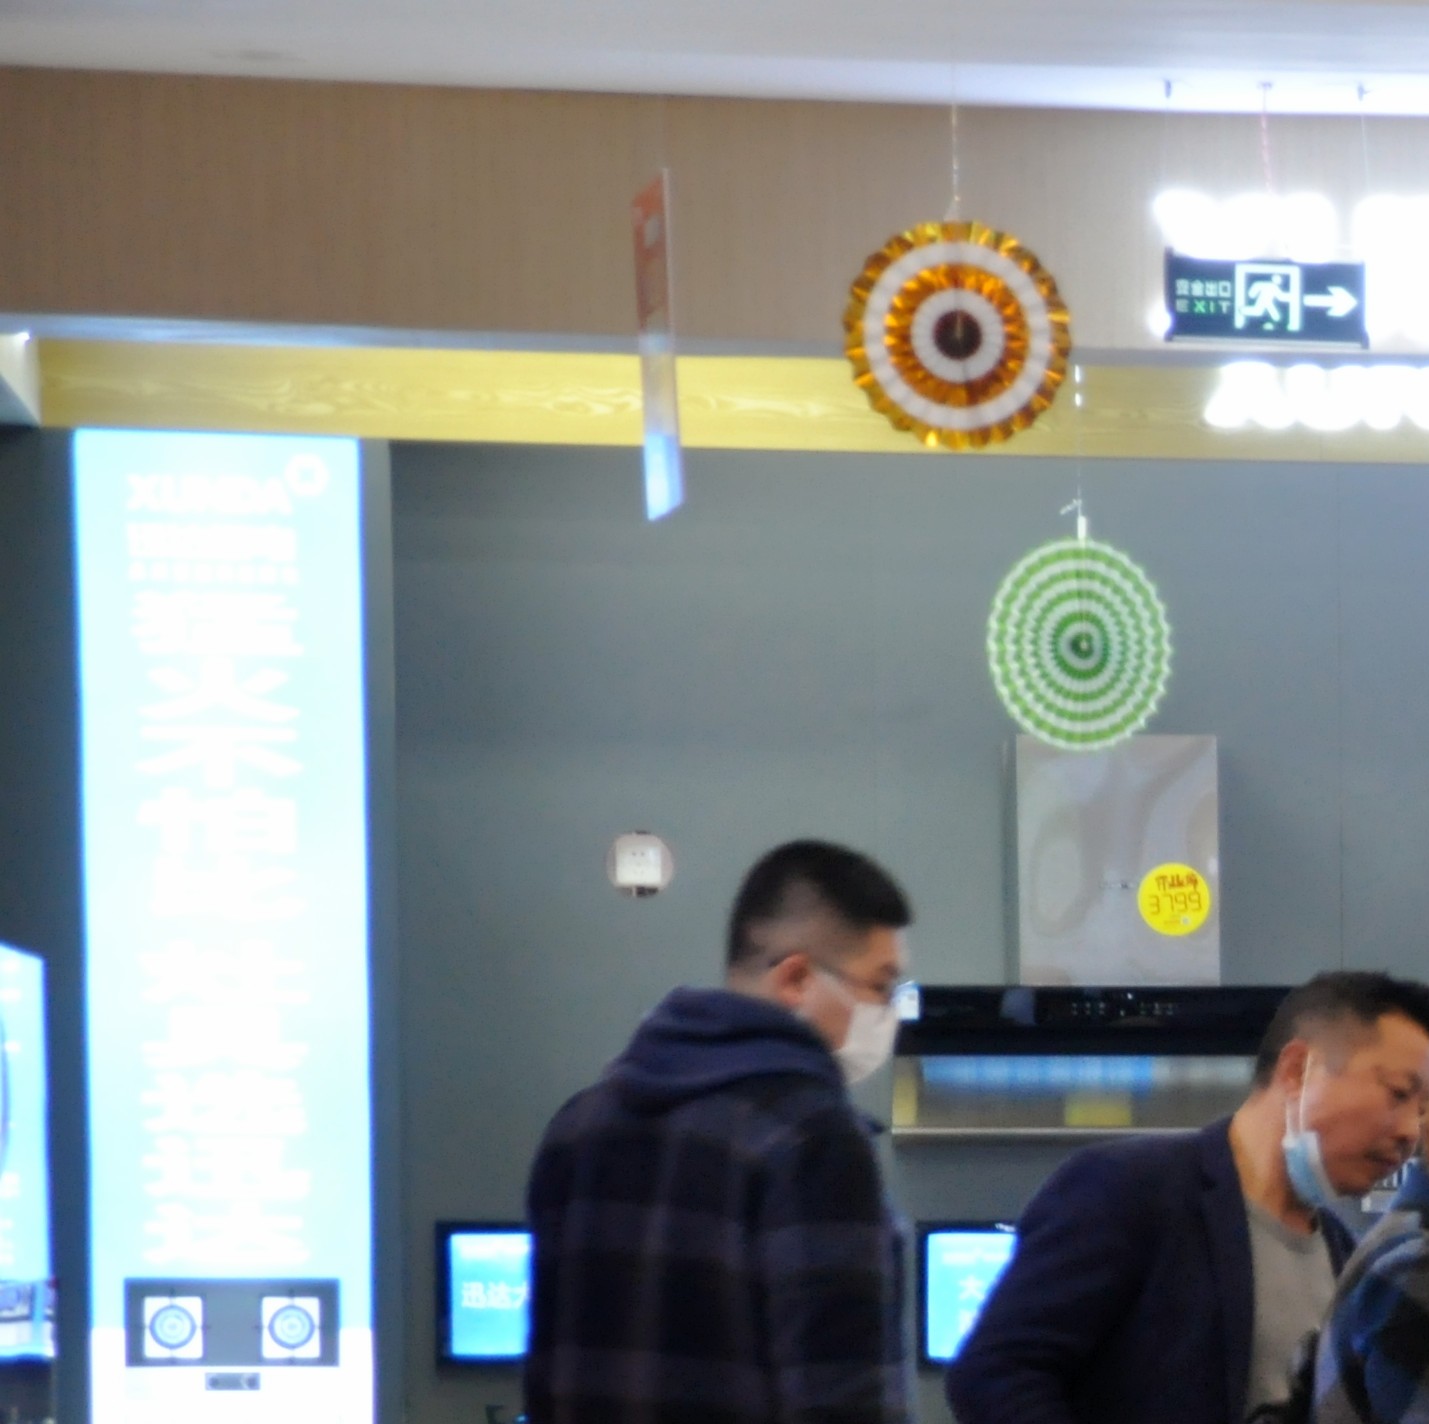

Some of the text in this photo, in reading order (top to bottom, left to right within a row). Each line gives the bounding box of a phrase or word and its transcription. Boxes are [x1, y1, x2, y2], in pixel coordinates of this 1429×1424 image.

[1175, 278, 1232, 297] 安全出口
[1175, 299, 1231, 314] EXIT
[1148, 892, 1203, 915] 3799
